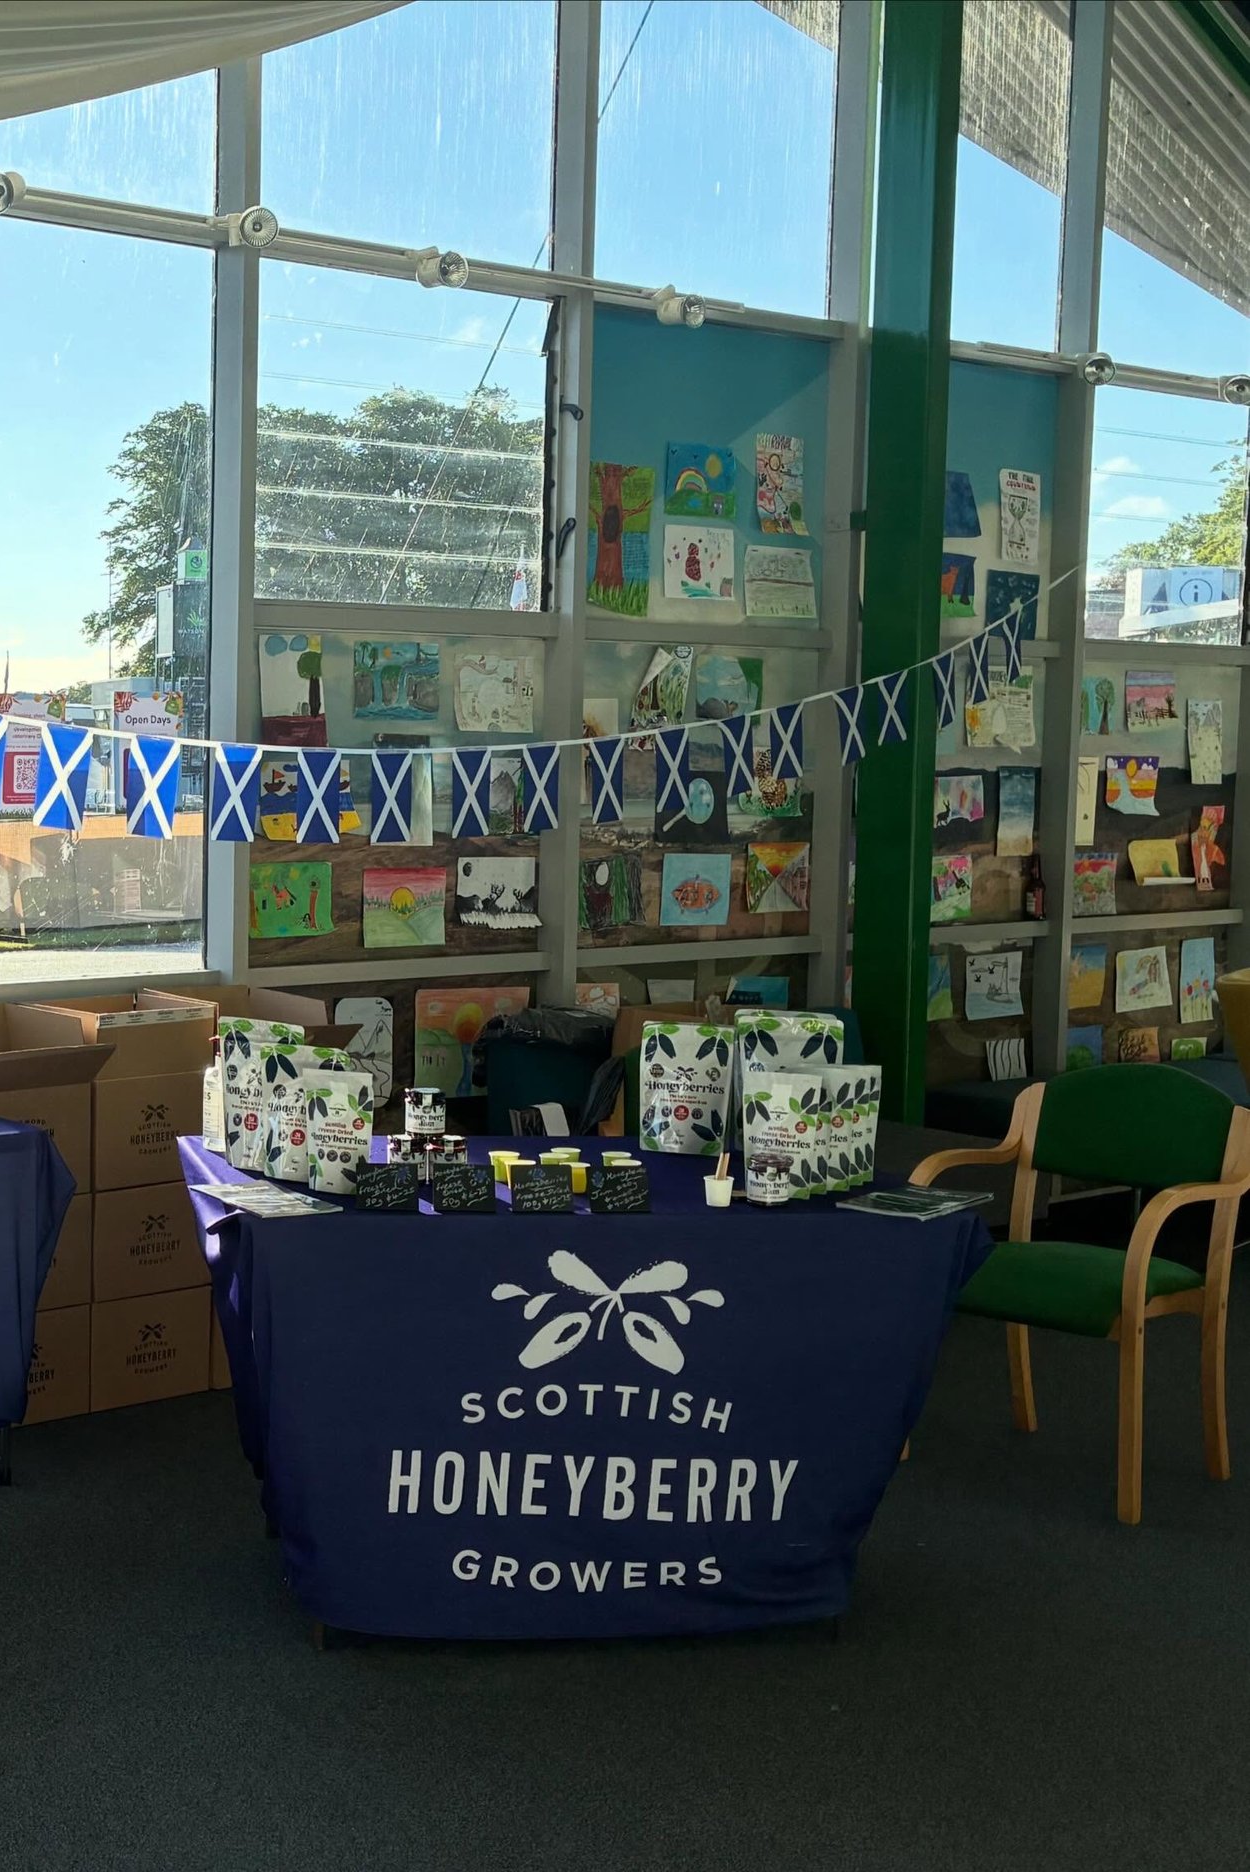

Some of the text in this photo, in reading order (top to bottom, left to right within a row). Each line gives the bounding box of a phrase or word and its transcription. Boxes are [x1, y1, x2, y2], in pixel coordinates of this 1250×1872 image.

[125, 714, 172, 726] Open Days
[460, 1383, 733, 1433] SCOTTISH
[388, 1449, 799, 1523] HONEYBERRY
[452, 1549, 722, 1592] GROWERS
